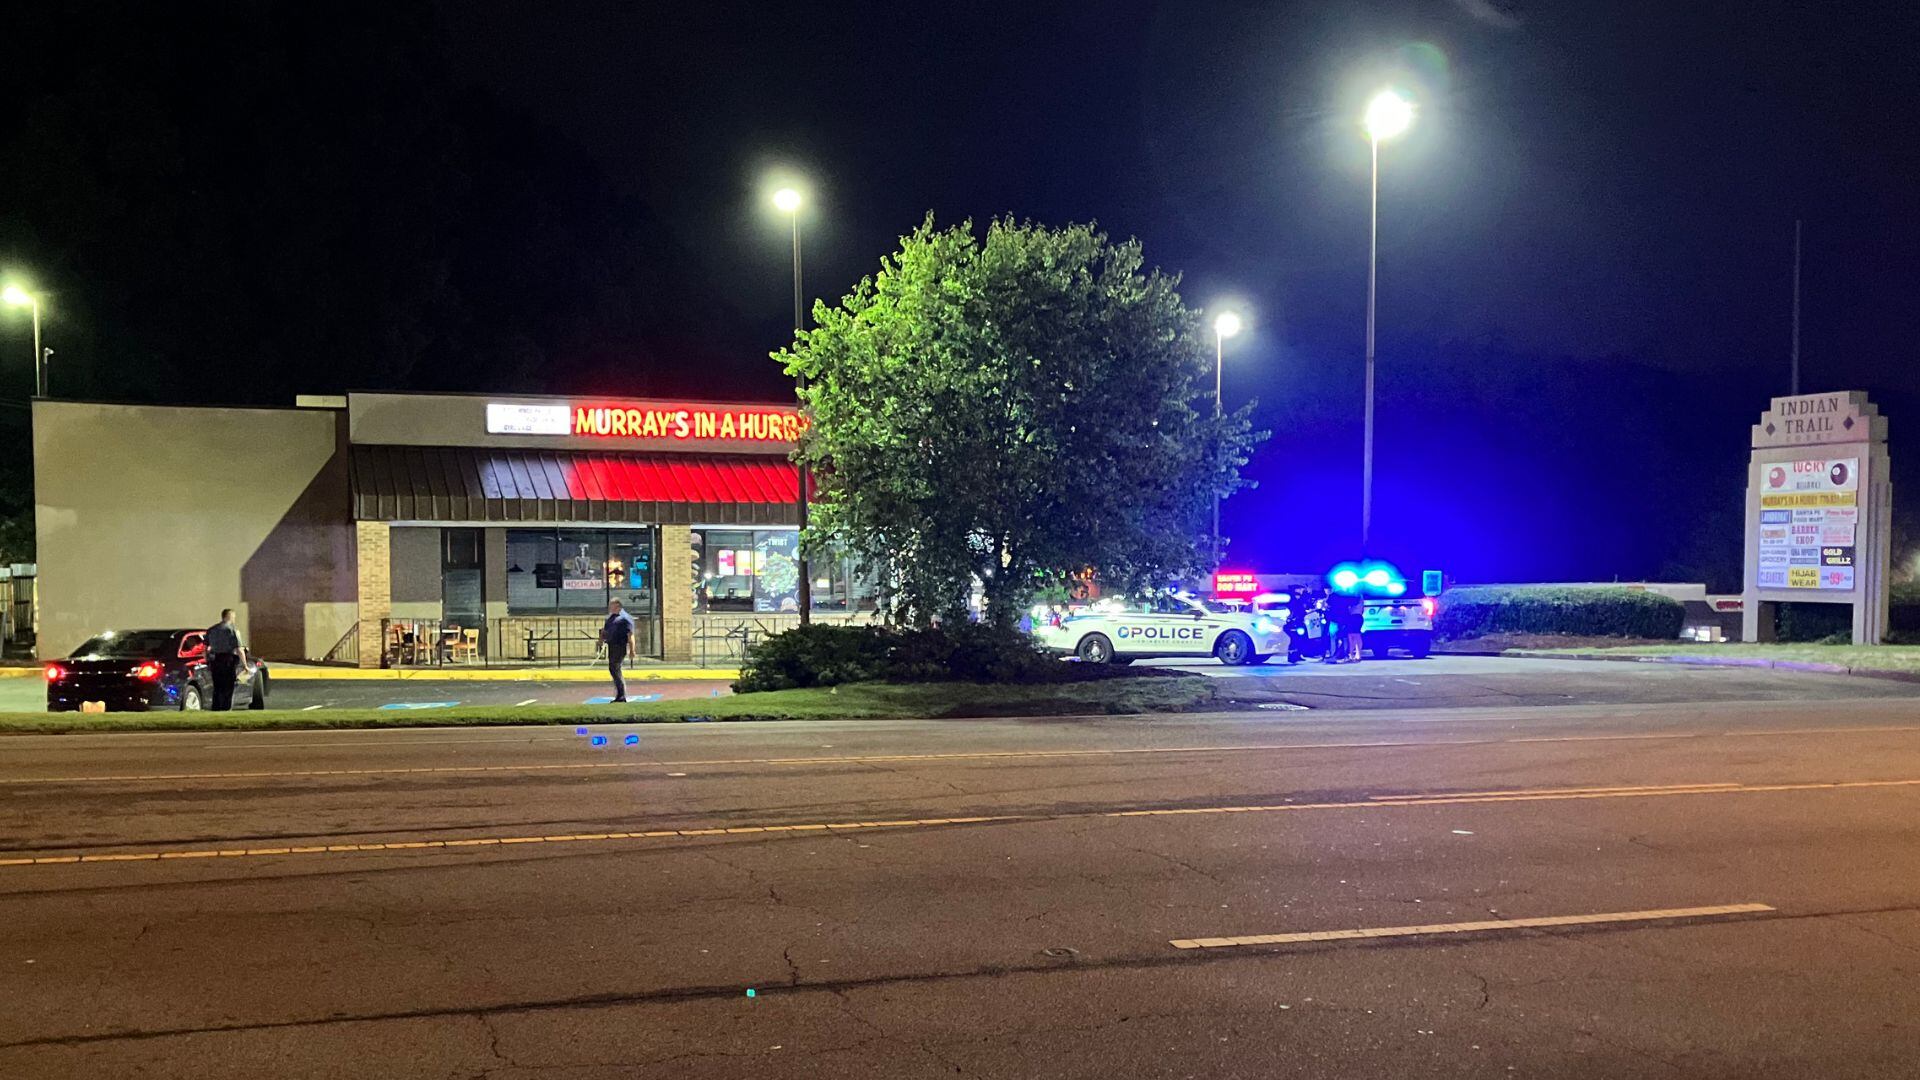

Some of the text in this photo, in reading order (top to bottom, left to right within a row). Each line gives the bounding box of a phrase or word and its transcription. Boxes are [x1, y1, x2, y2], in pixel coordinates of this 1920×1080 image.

[1781, 398, 1838, 416] INDIAN
[576, 408, 689, 438] MURRAY'S
[694, 411, 718, 437] IN
[720, 412, 736, 438] A
[1785, 417, 1833, 434] TRAIL
[1793, 460, 1826, 473] LUCKY
[1795, 535, 1815, 545] SHOP
[1791, 569, 1817, 578] HIJAB
[565, 580, 601, 588] HOOKAH
[1791, 579, 1817, 587] WEAR
[1131, 627, 1204, 639] POLICE
